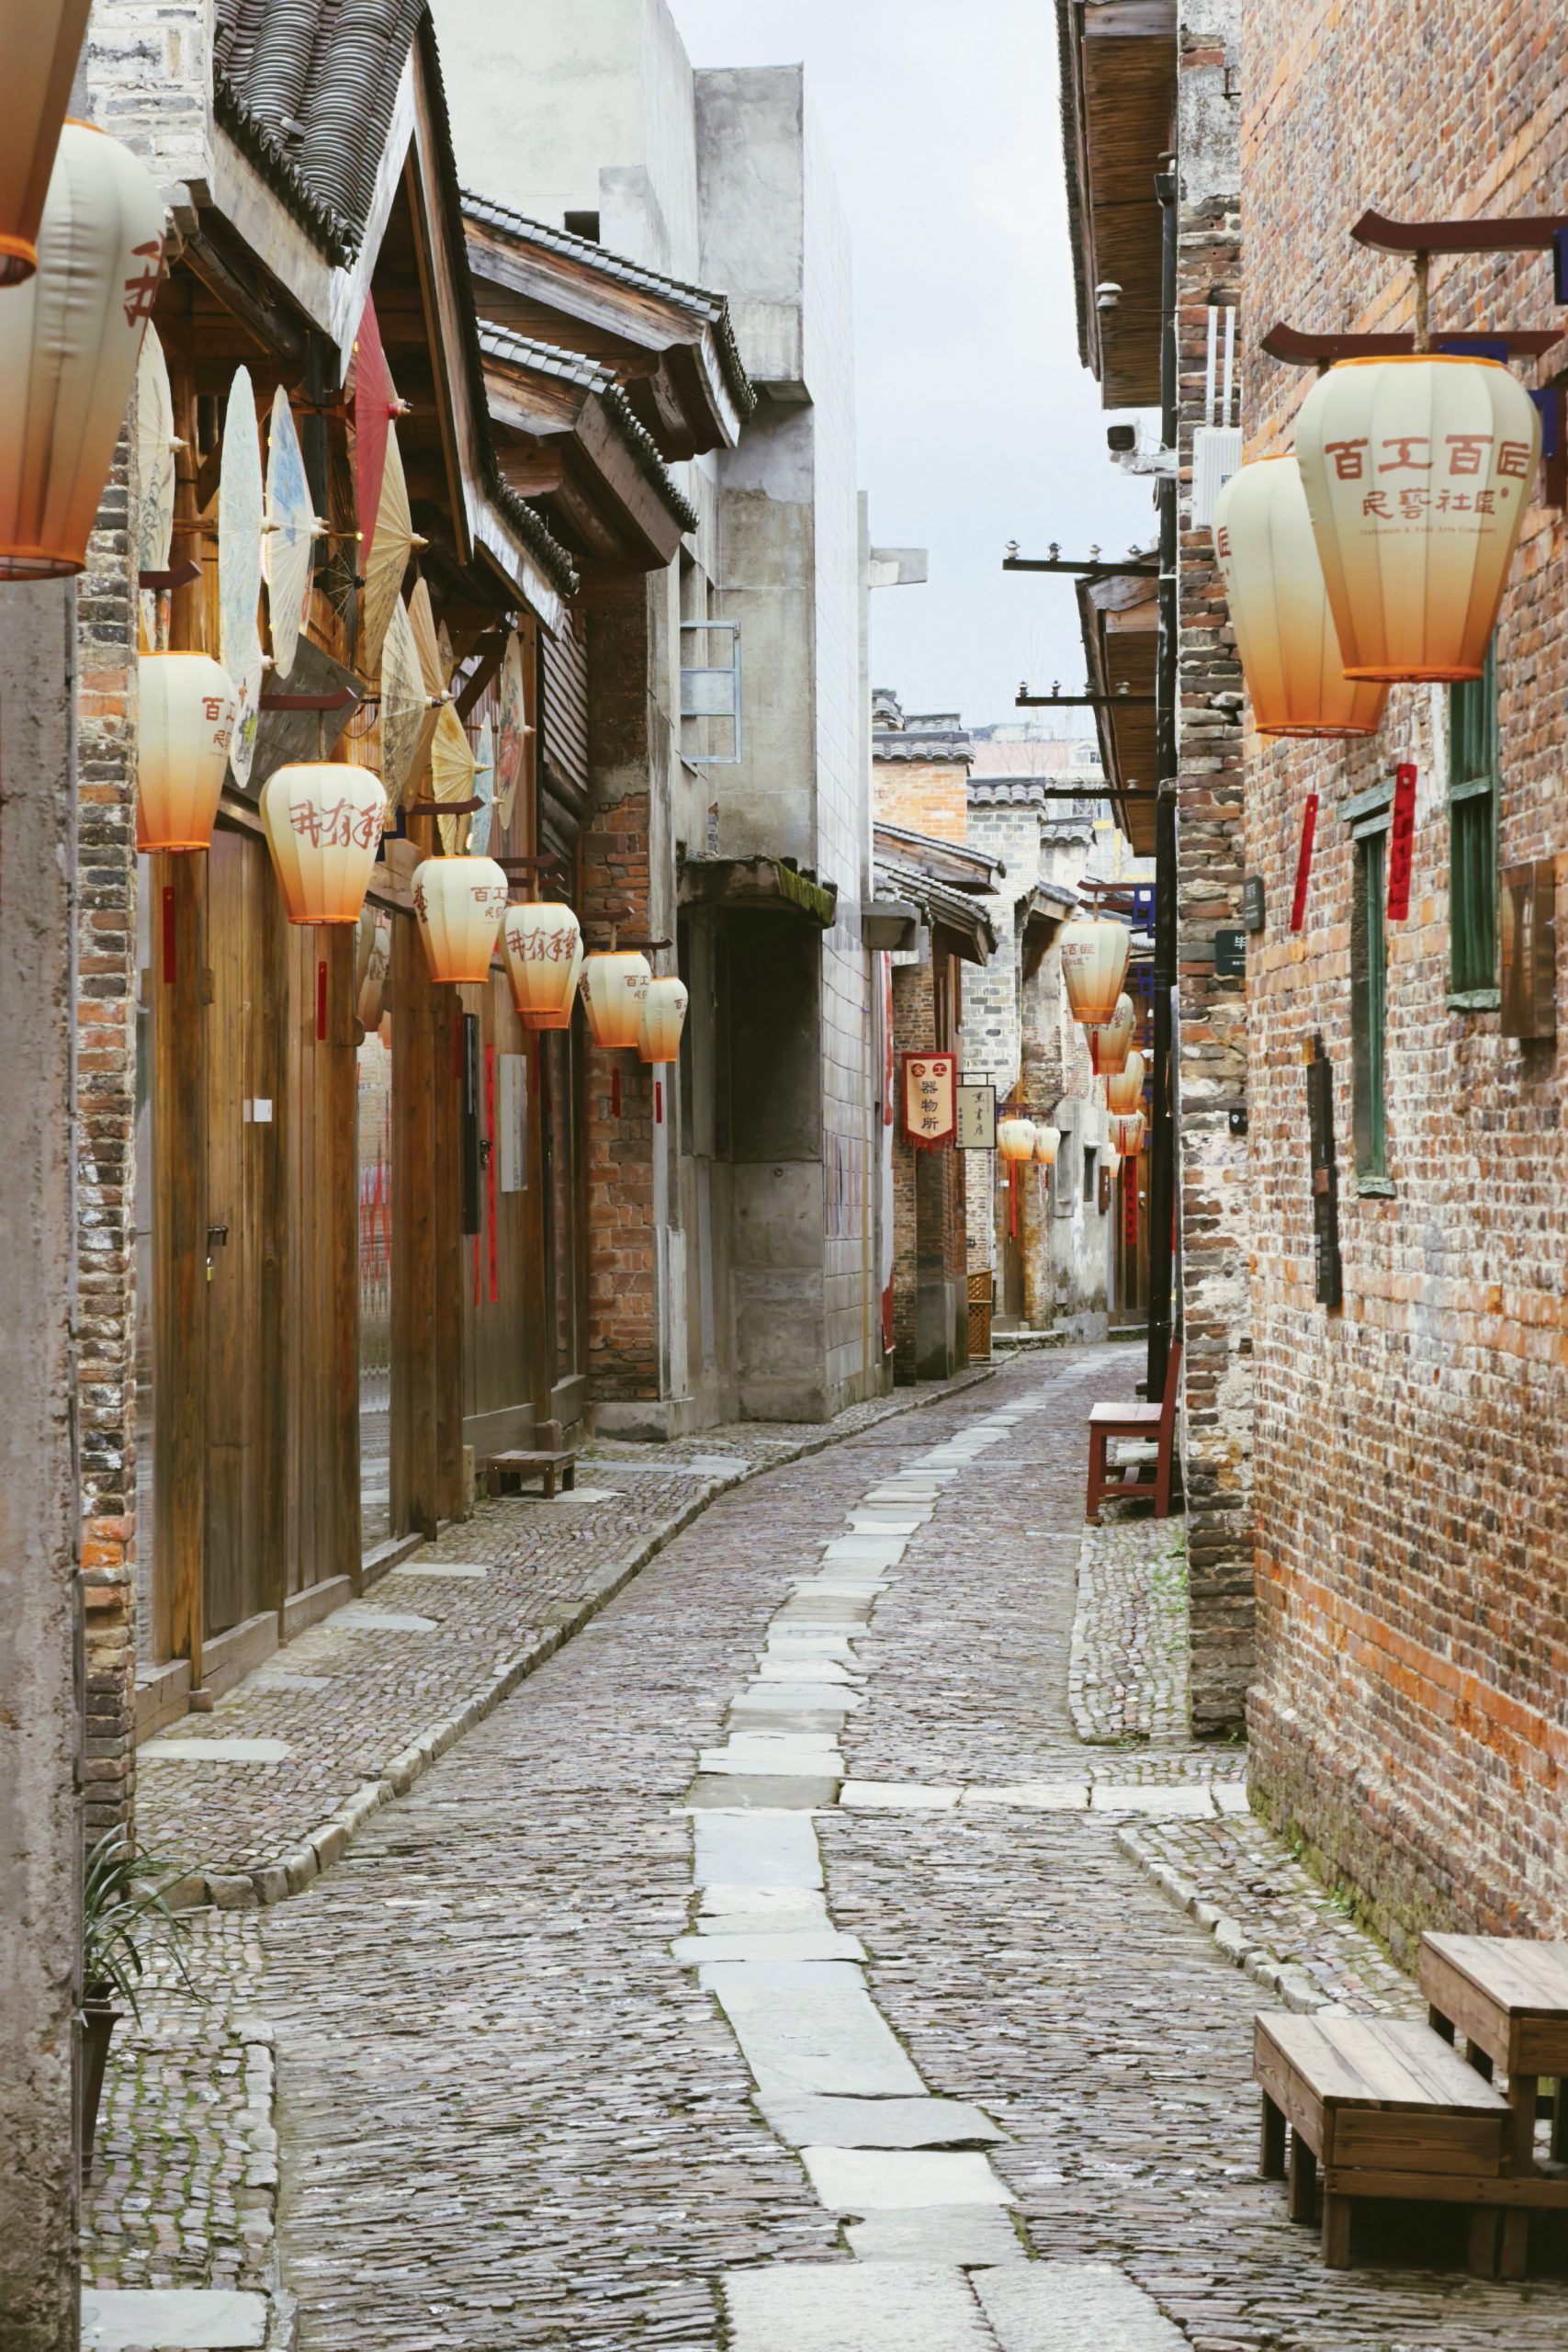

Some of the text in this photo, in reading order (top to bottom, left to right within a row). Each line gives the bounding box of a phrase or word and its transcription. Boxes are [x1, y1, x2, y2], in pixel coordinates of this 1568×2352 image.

[1324, 434, 1530, 481] 百工百匠
[1361, 488, 1496, 520] 民藝社區
[920, 1080, 939, 1131] 器物所
